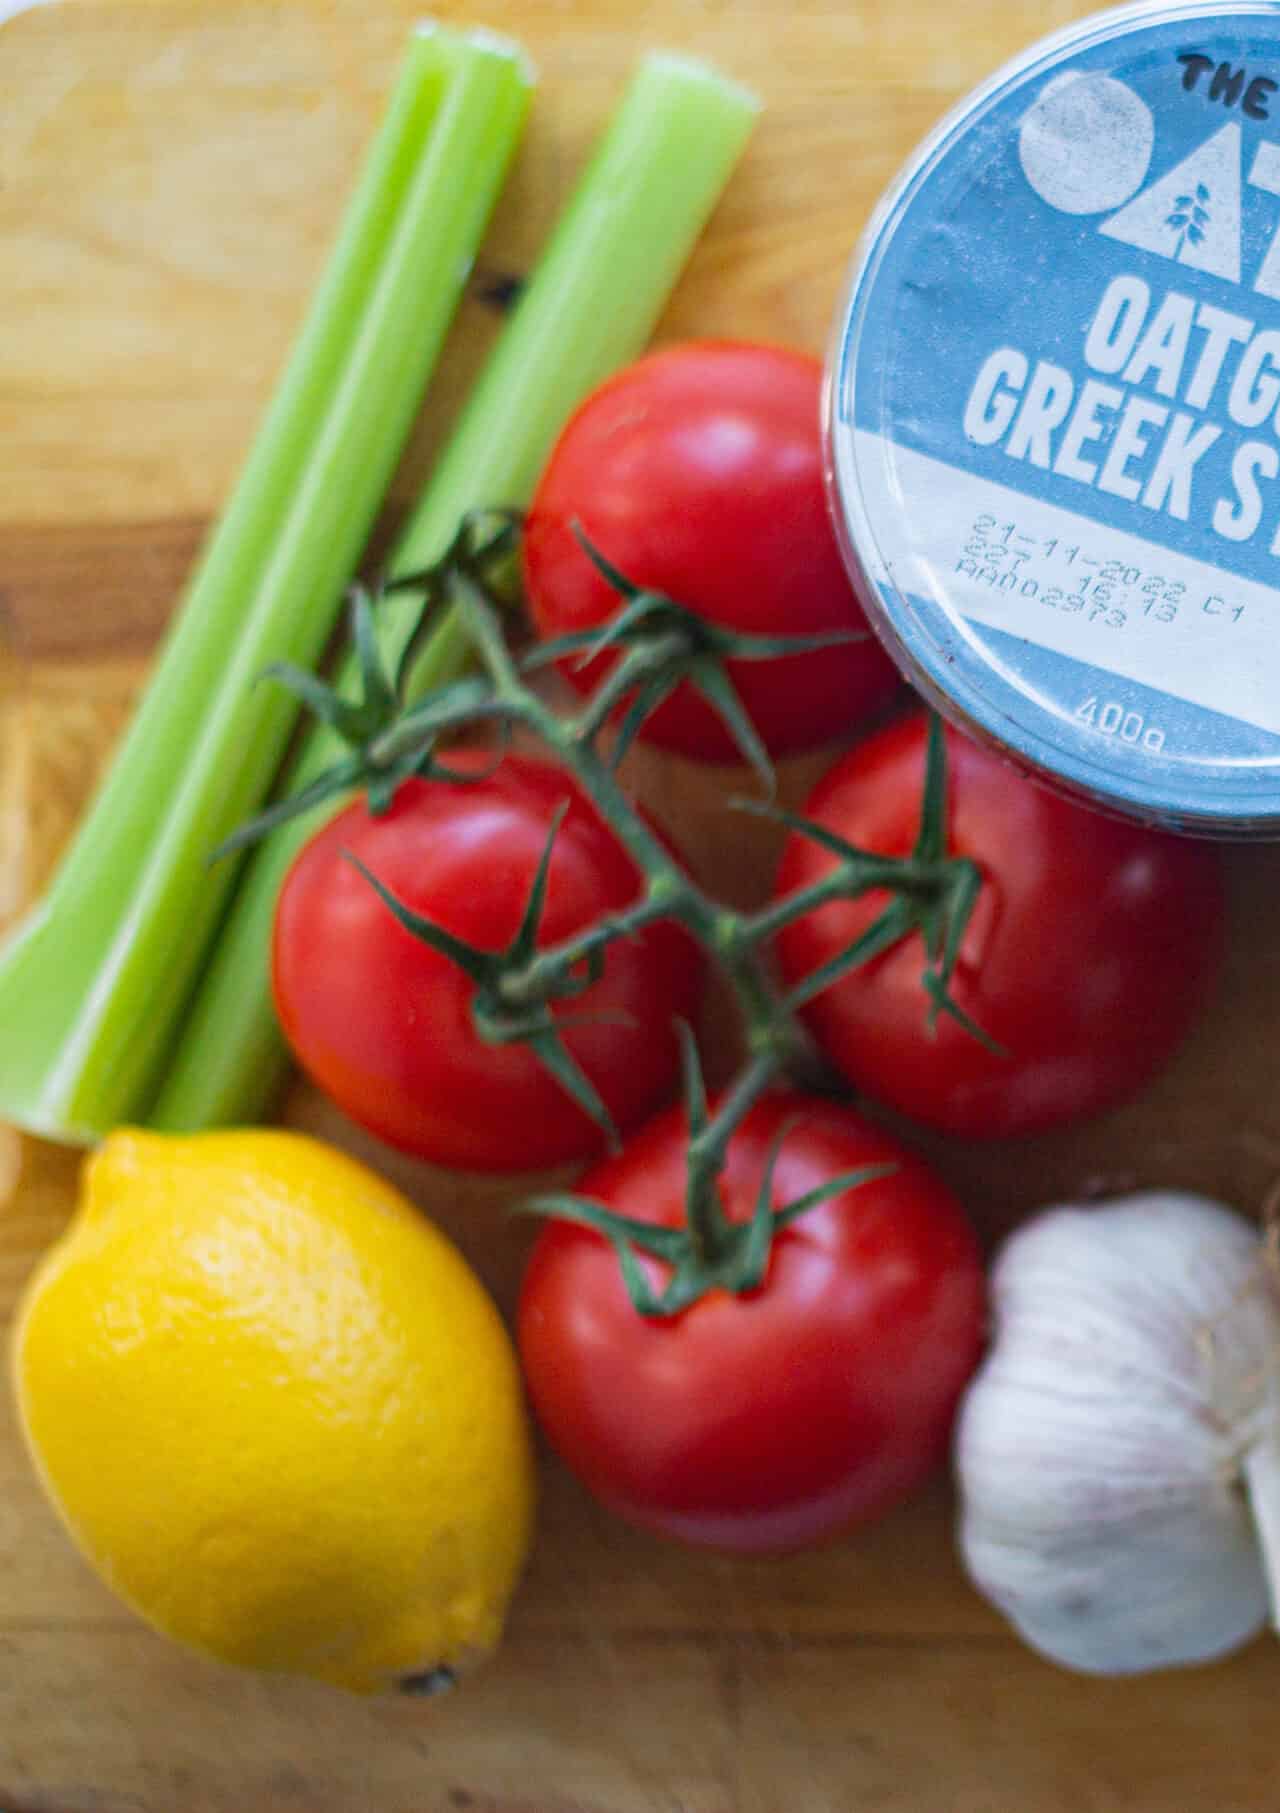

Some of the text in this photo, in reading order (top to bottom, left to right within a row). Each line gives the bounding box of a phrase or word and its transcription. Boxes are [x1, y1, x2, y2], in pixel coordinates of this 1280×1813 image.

[1177, 54, 1278, 121] THE
[962, 348, 1221, 521] GREEK
[972, 513, 1246, 623] 21-11-2022 C1
[1075, 697, 1166, 752] 400g
